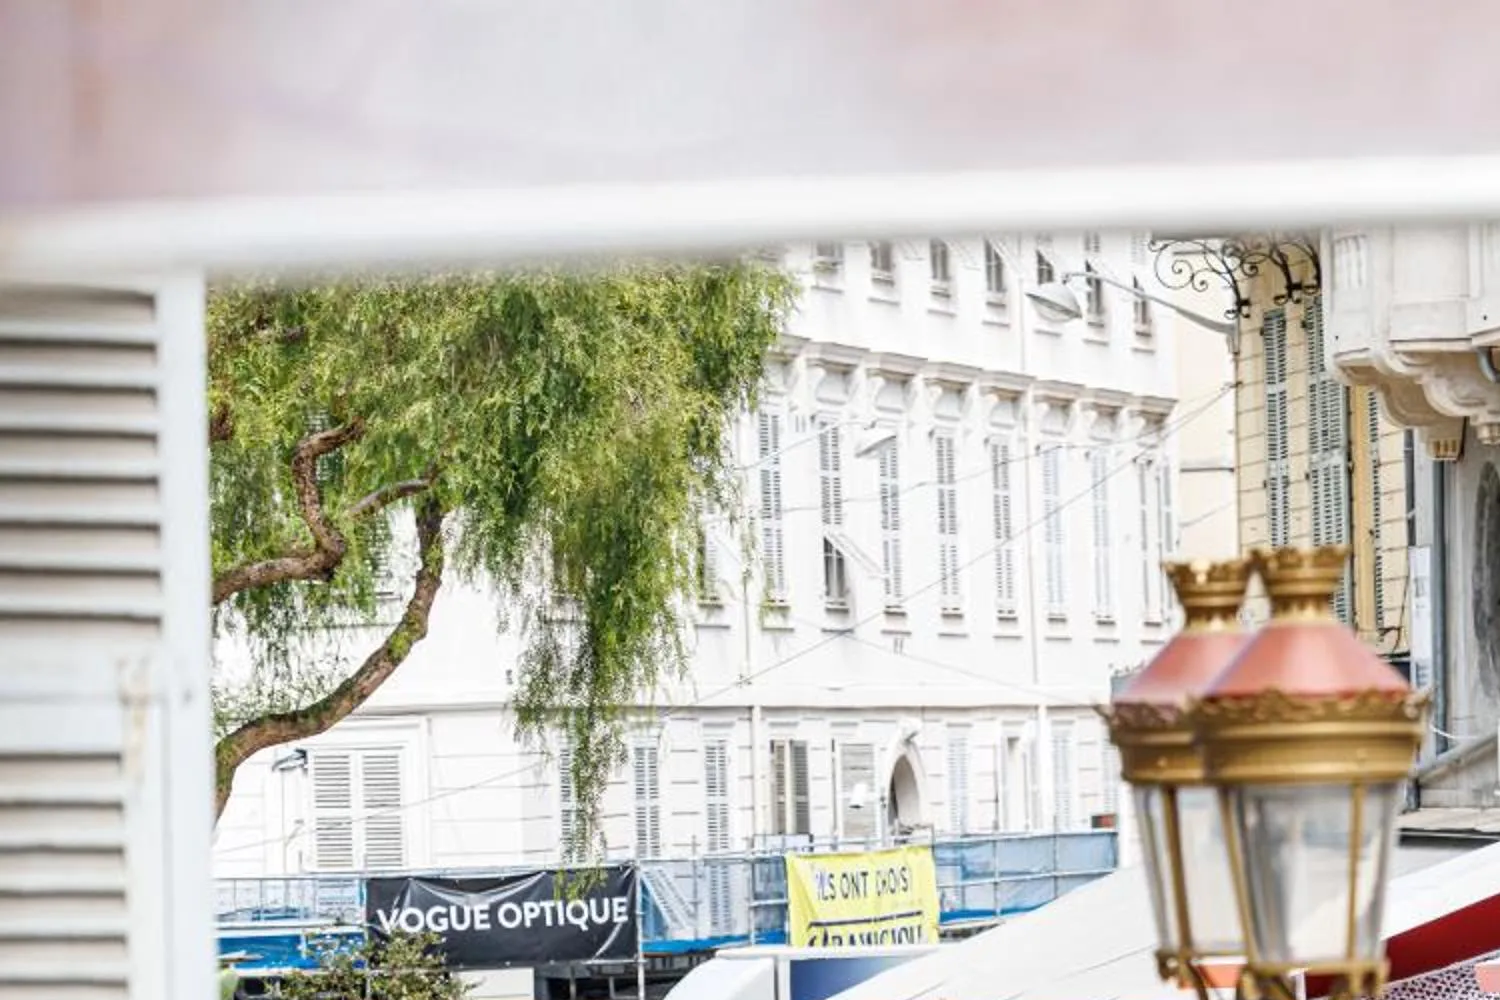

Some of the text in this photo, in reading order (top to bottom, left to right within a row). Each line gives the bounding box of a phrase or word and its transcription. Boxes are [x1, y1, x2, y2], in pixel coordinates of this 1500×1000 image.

[840, 871, 868, 899] ONT
[377, 897, 629, 936] VOGUE OPTIQUE
